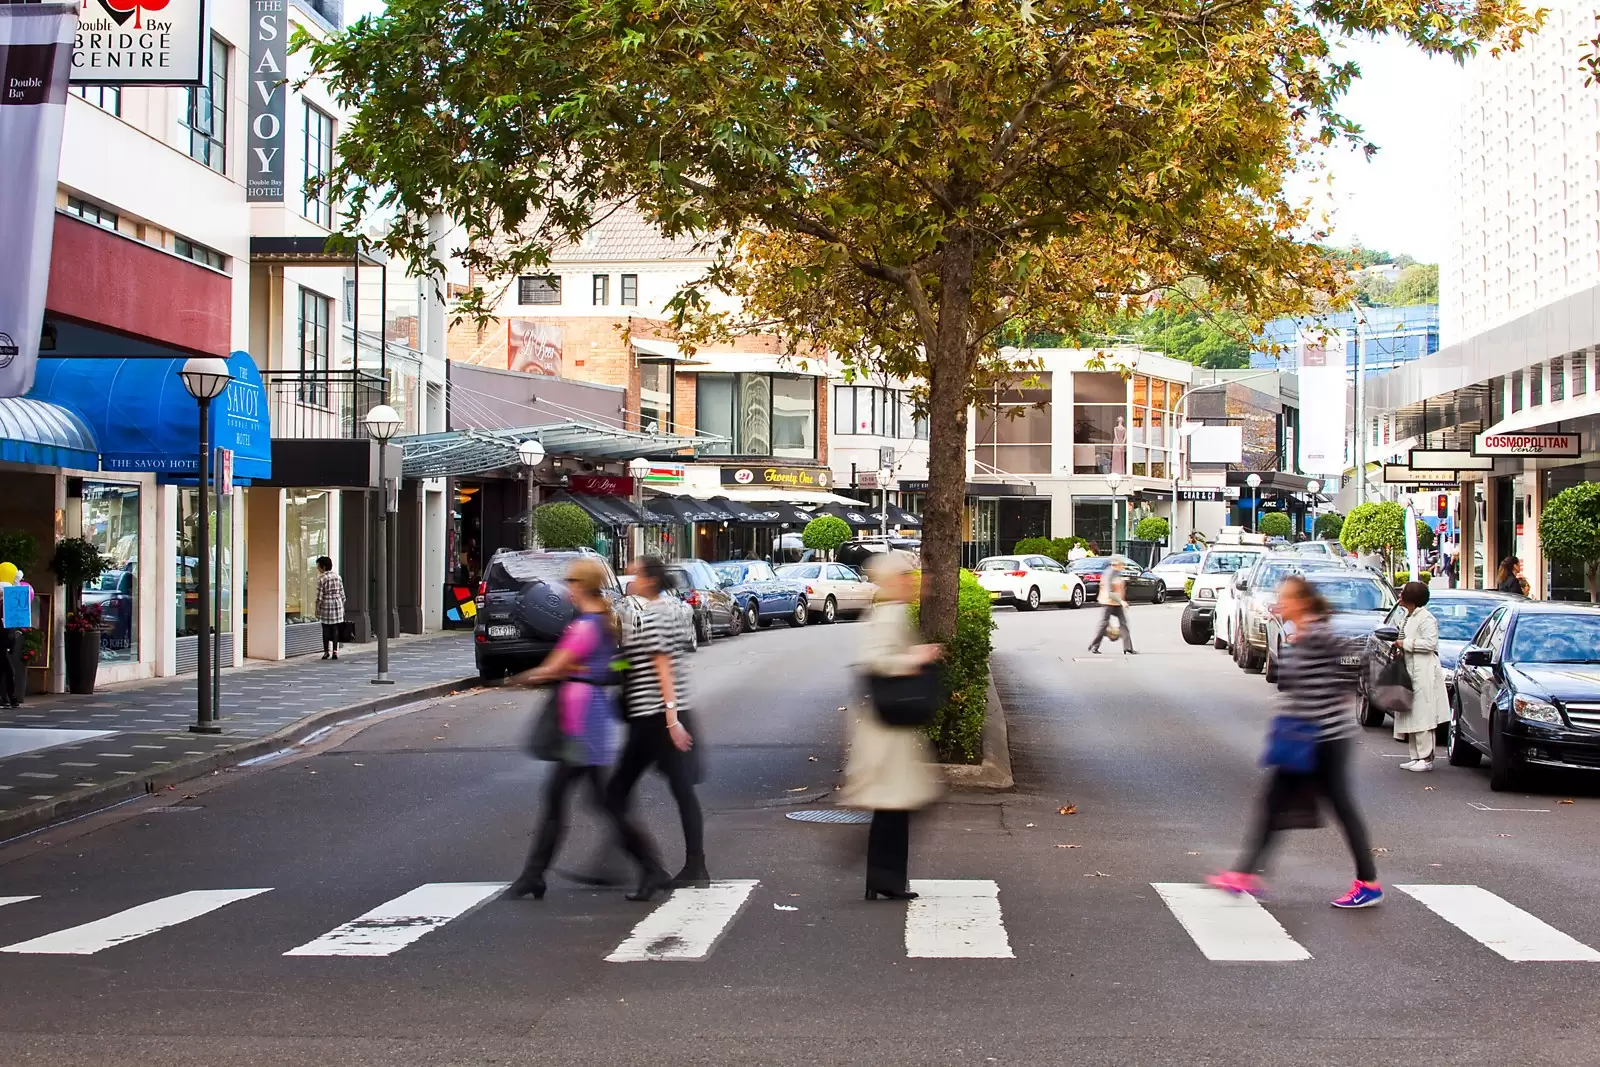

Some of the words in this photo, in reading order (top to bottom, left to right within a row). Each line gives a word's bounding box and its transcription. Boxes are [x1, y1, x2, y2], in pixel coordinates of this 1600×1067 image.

[256, 1, 282, 12] THE
[75, 19, 113, 31] Double
[73, 33, 171, 49] BRIDGE
[71, 52, 170, 67] CENTRE
[10, 77, 43, 88] Double
[8, 88, 25, 100] Bay
[253, 15, 281, 173] SAVOY
[270, 179, 282, 187] Bay
[248, 187, 282, 197] HOTEL
[239, 366, 248, 380] THE
[227, 383, 259, 417] SAVOY
[236, 432, 250, 446] HOTEL
[1485, 436, 1568, 449] COSMOPOLITAN
[111, 459, 132, 468] THE
[135, 459, 166, 468] SAVOY
[170, 460, 199, 469] HOTE
[739, 472, 750, 481] 21
[764, 468, 798, 486] Twenty
[799, 471, 814, 484] One
